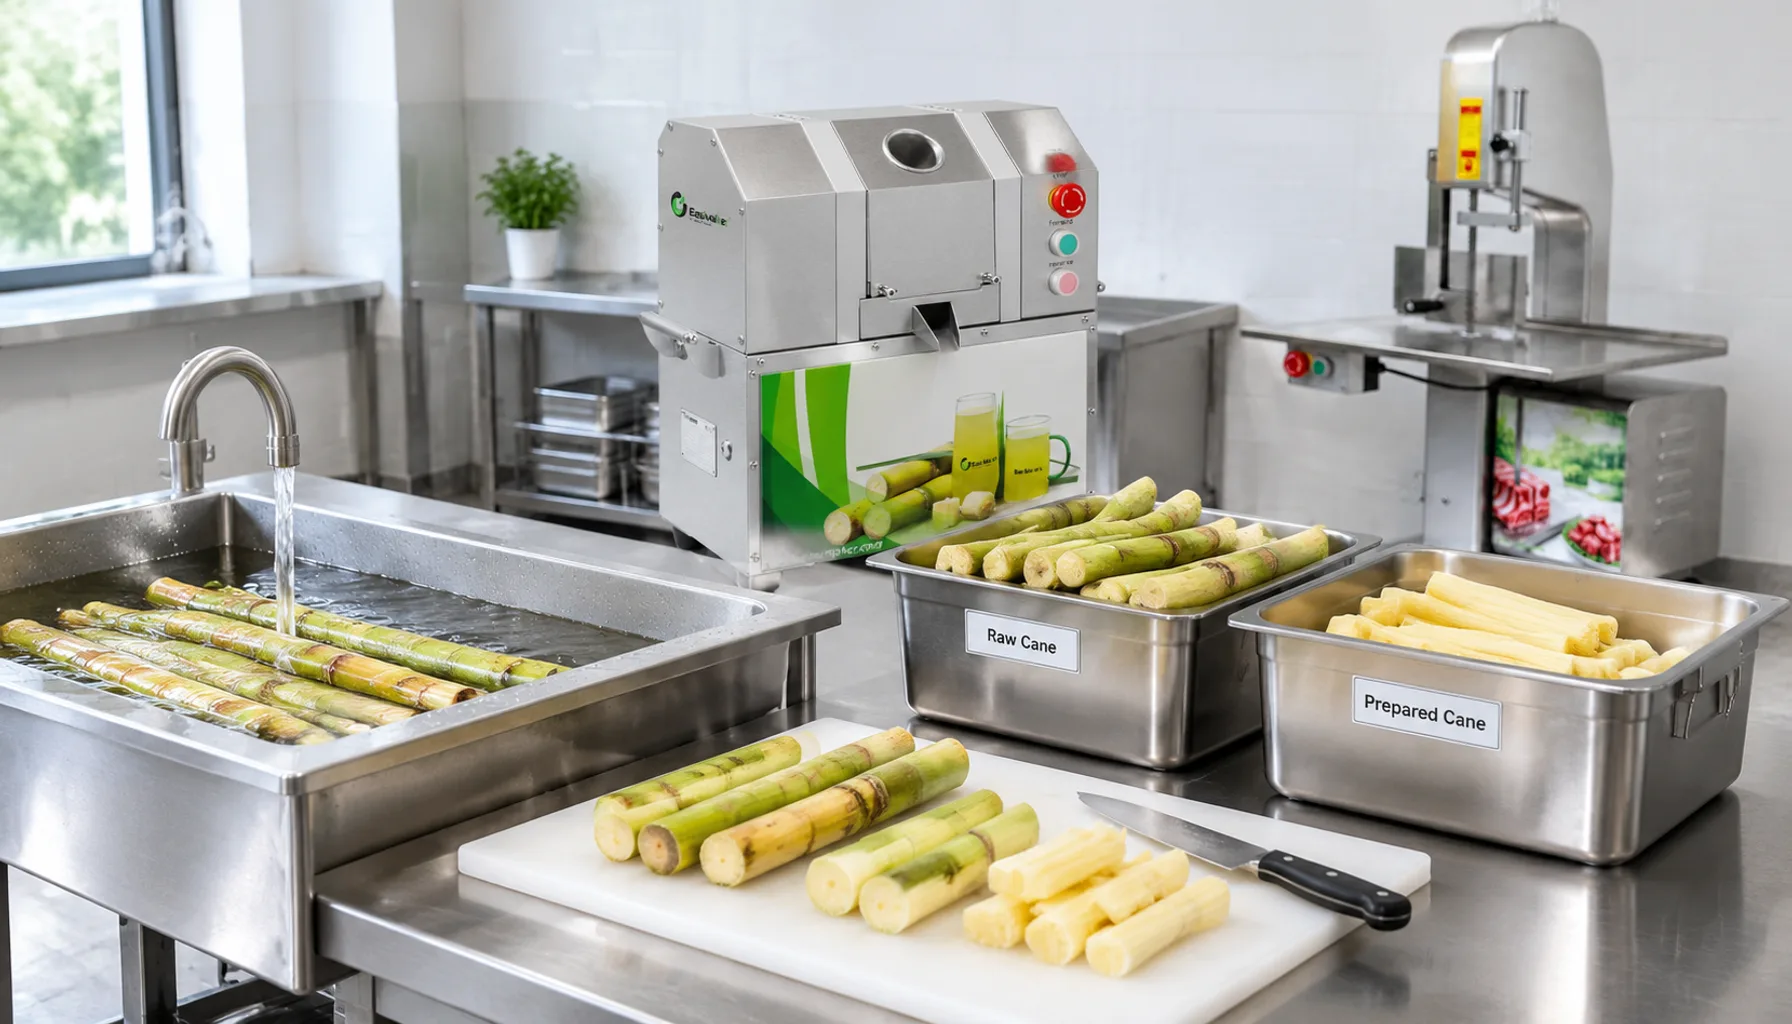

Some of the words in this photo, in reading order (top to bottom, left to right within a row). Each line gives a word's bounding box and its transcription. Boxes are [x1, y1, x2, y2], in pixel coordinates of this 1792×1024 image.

[987, 628, 1017, 646] Raw
[1020, 635, 1057, 655] Cane
[1364, 694, 1438, 723] Prepared
[1443, 709, 1487, 731] Cane
